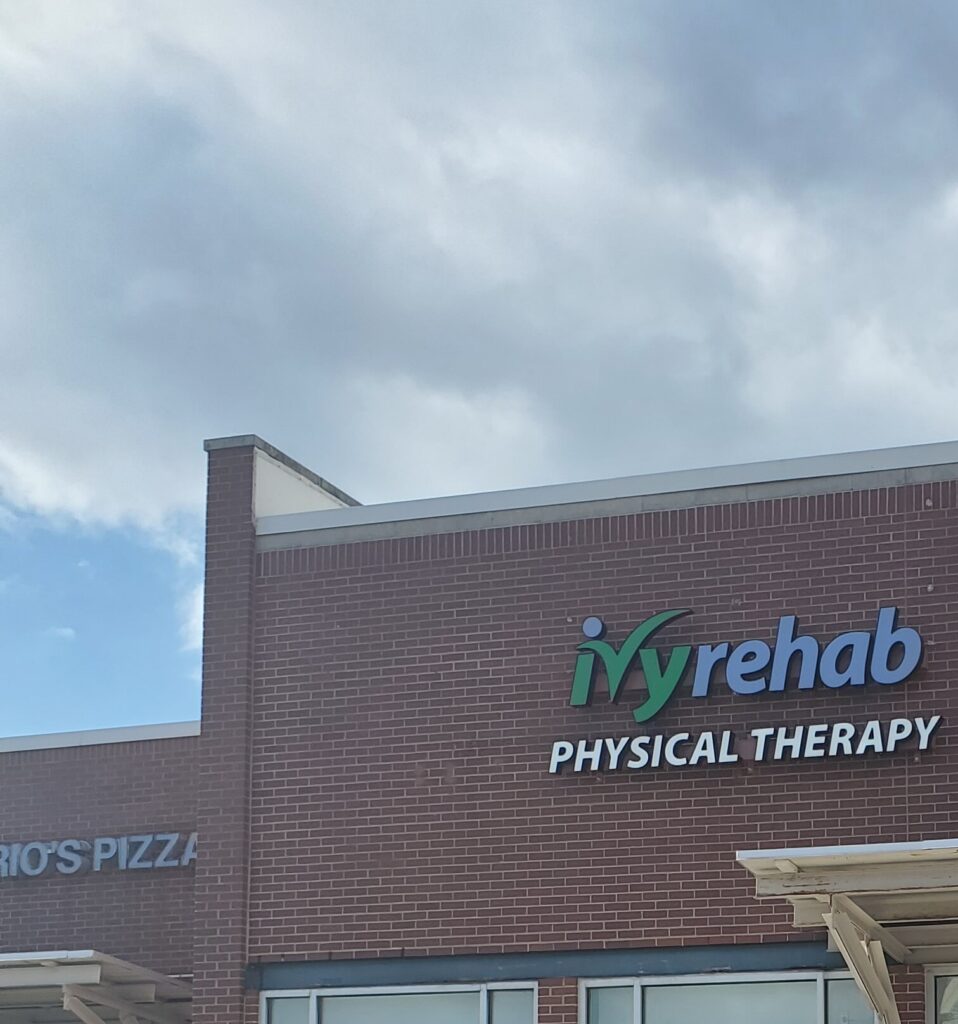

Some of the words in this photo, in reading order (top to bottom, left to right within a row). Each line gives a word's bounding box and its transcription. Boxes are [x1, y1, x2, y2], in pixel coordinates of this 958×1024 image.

[570, 606, 922, 723] ivyrehab
[548, 730, 739, 773] PHYSICAL
[750, 715, 942, 761] THERAPY
